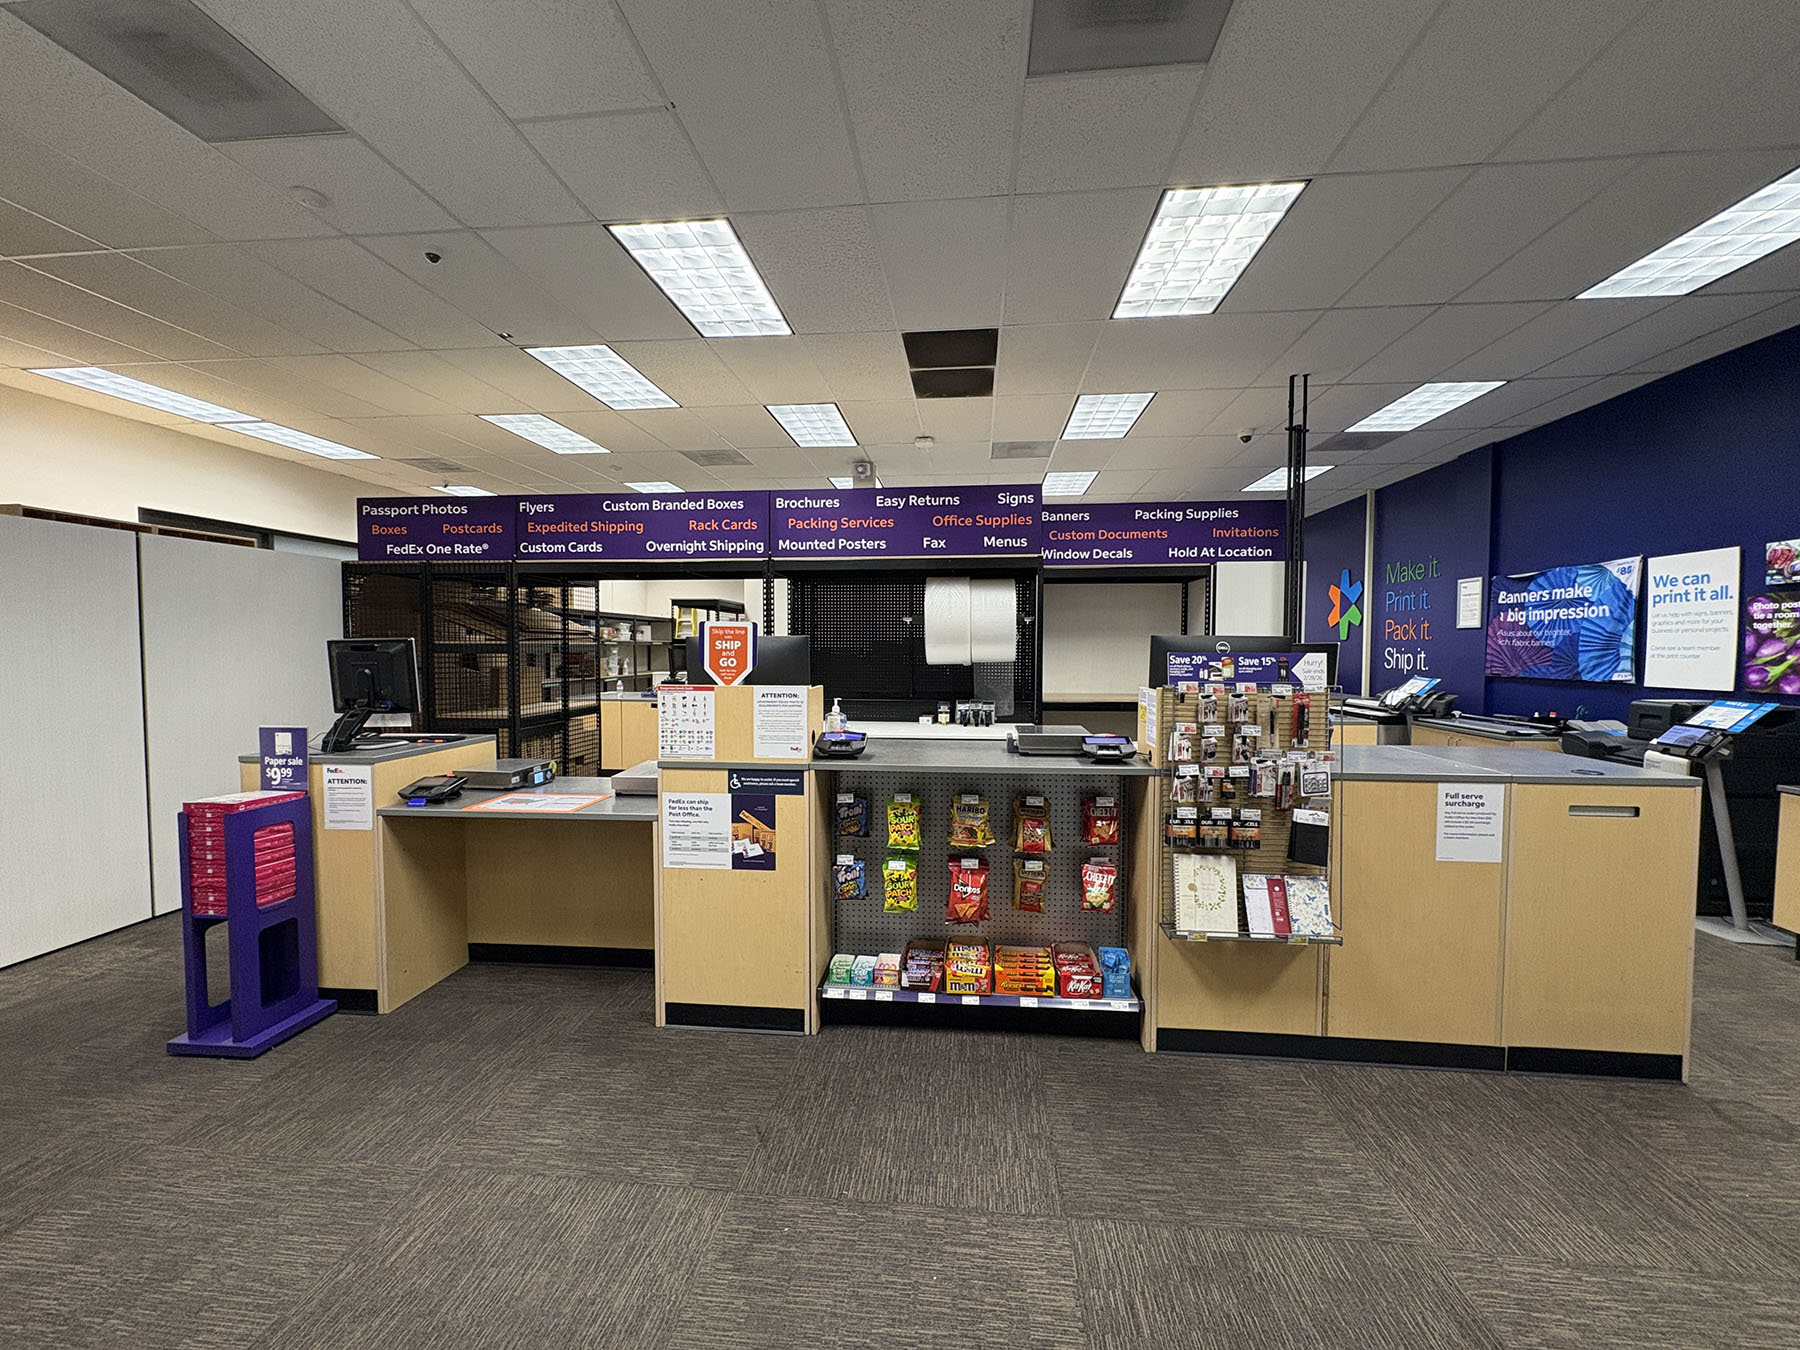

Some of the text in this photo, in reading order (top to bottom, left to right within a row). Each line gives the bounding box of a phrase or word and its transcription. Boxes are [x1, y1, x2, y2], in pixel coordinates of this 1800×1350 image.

[603, 499, 744, 511] Custom Branded Boxes
[776, 497, 840, 508] Brochures
[876, 495, 960, 509] Easy Returns
[998, 493, 1034, 506] Signs
[362, 504, 467, 517] Passport Photos
[519, 502, 554, 514] Flyers
[932, 514, 1032, 527] Office Supplies
[1042, 511, 1090, 521] Banners
[1135, 508, 1238, 522] Packing Supplies
[372, 525, 407, 535] Boxes
[442, 523, 502, 534] Postcards
[528, 521, 643, 534] Expedited Shipping
[689, 519, 757, 531] Rack Cards
[788, 517, 894, 532] Packing Services
[1049, 529, 1168, 540] Custom Documents
[1212, 527, 1279, 538] Invitations
[646, 540, 764, 554] Overnight Shipping
[779, 538, 886, 550] Mounted Posters
[923, 538, 946, 548] Fax
[984, 536, 1028, 547] Menus
[387, 544, 424, 554] FedEx
[426, 544, 451, 554] One
[519, 542, 602, 553] Custom Cards
[1168, 547, 1272, 558] Hold At Location
[1042, 548, 1132, 560] Window Decals
[1387, 555, 1440, 584] Make it.
[1653, 573, 1710, 588] We can
[1498, 584, 1592, 604] Banners make
[1653, 585, 1733, 607] print it all.
[1386, 588, 1430, 612] Print it.
[1507, 608, 1526, 625] big
[1529, 603, 1610, 623] impression
[1386, 618, 1432, 640] Pack it.
[1753, 622, 1793, 630] together.
[715, 640, 741, 649] SHIP
[719, 658, 736, 667] GO
[1170, 656, 1207, 664] Save 20%
[1238, 657, 1276, 666] Save 15%
[1384, 648, 1428, 674] Ship it.
[264, 756, 303, 767] Paper sale
[956, 805, 985, 815] HARIBO
[891, 816, 914, 824] SOUR
[888, 881, 910, 889] SOUR
[954, 883, 980, 894] Doritos
